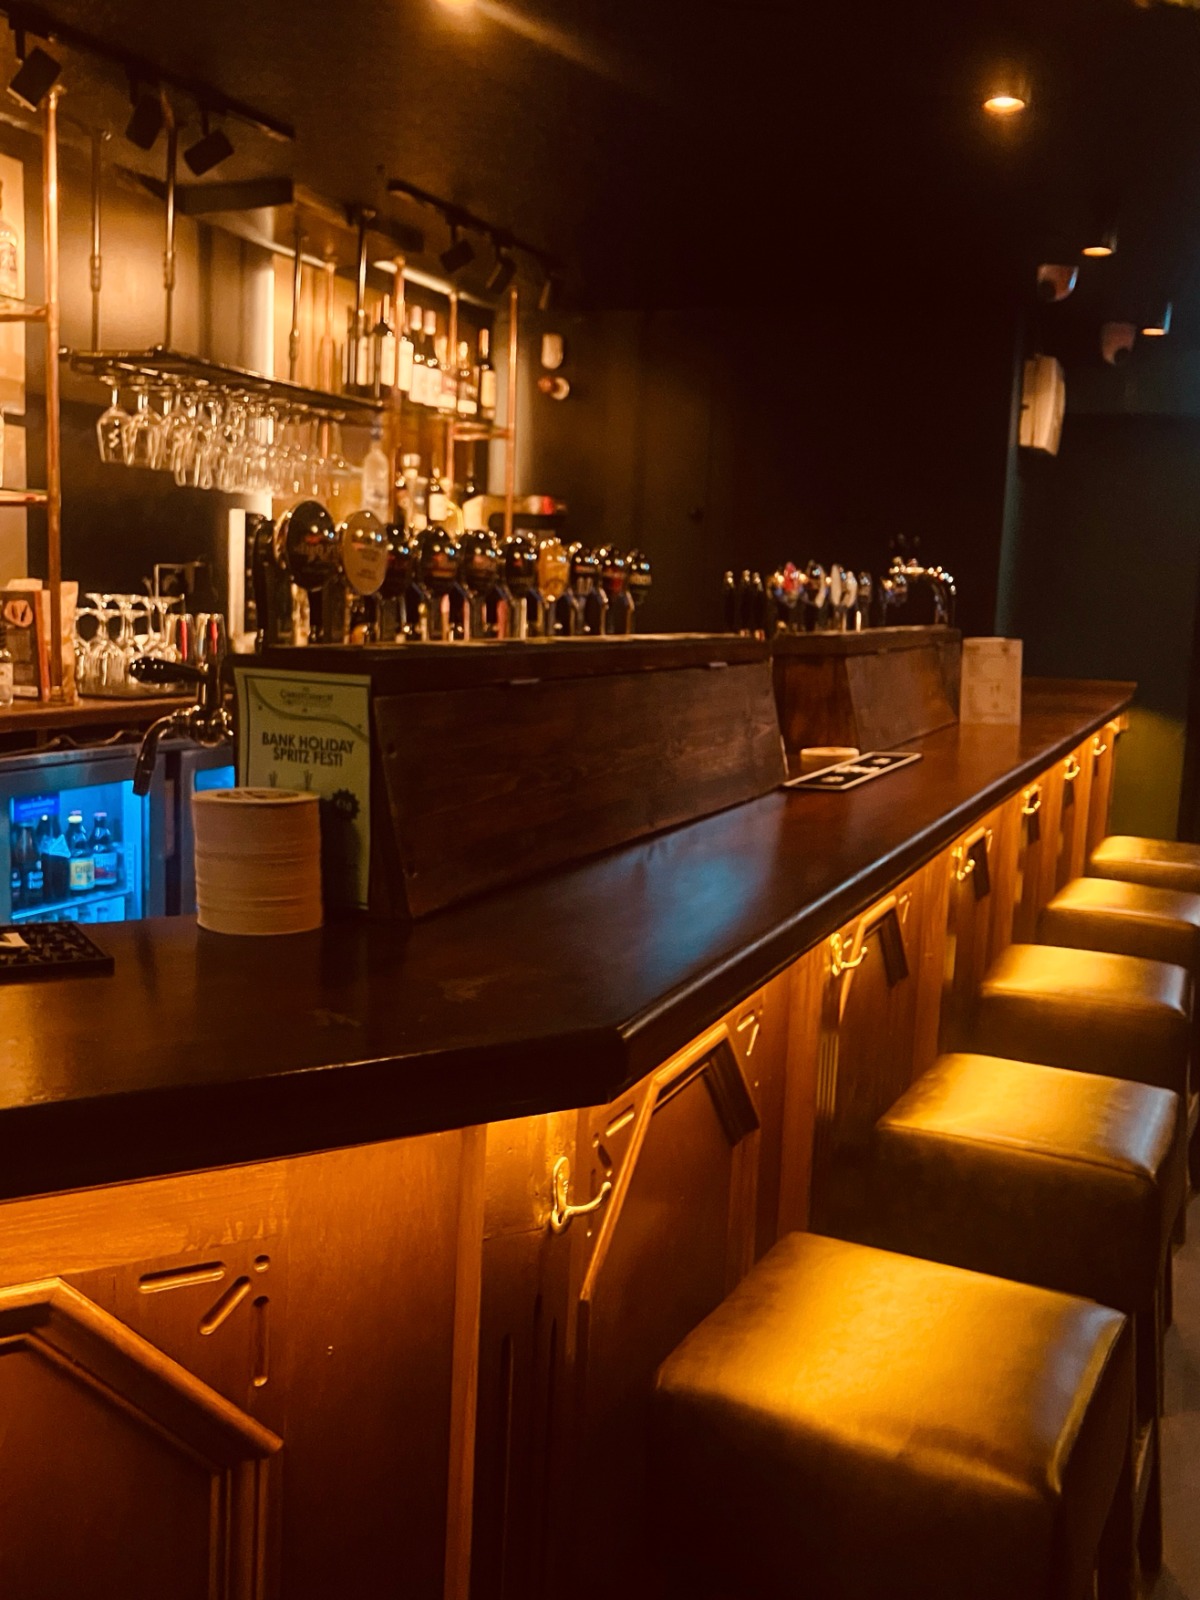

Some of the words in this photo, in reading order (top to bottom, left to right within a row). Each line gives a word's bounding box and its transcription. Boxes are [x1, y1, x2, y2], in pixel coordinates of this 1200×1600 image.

[262, 731, 296, 748] BANK
[299, 735, 355, 755] HOLIDAY
[273, 746, 310, 764] SPRITZ
